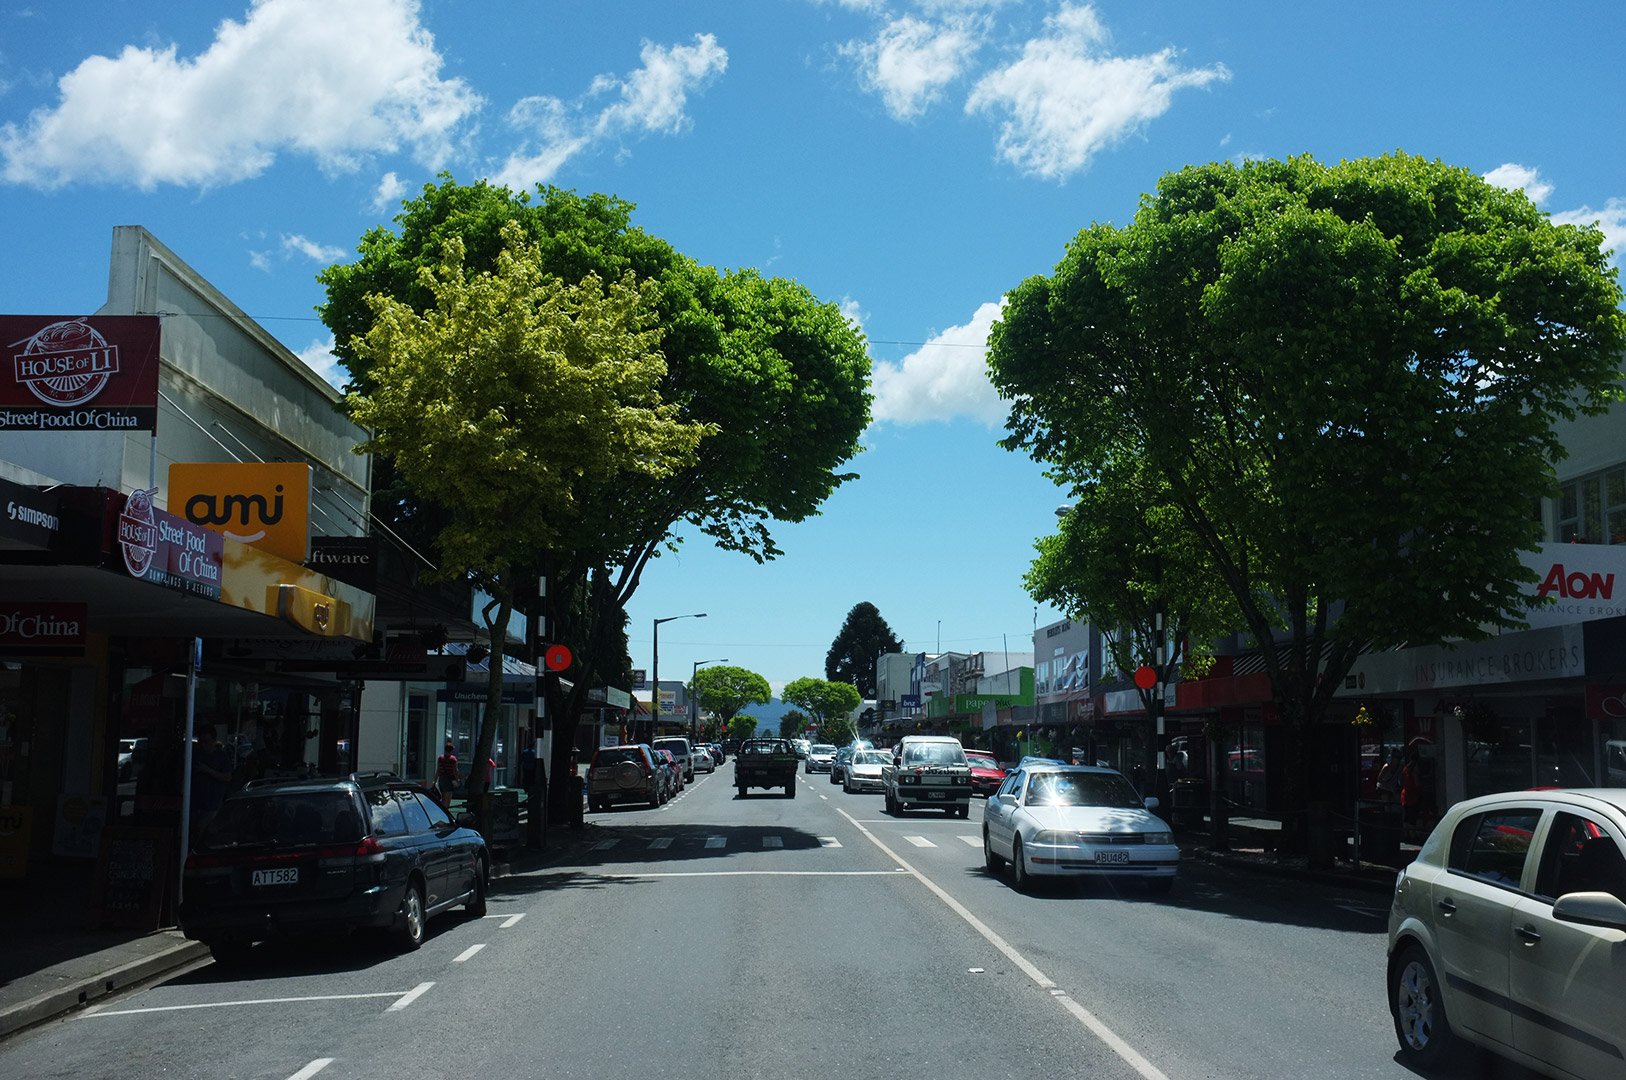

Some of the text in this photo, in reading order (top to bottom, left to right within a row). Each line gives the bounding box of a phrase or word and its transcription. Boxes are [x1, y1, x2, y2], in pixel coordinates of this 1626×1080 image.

[20, 355, 75, 376] HOUSE
[90, 349, 111, 371] LI
[0, 410, 39, 427] Street
[39, 410, 74, 429] Food
[95, 411, 138, 429] China
[184, 484, 284, 526] ami
[121, 520, 142, 542] HOUSE
[146, 528, 155, 548] LI
[159, 520, 206, 554] Street Food
[179, 552, 218, 581] Of China
[312, 550, 370, 564] ftware
[149, 569, 182, 589] DUMPLINGS
[192, 583, 213, 597] KEBABS
[1536, 563, 1615, 600] AON
[1514, 604, 1582, 615] SURANCE
[18, 614, 80, 638] China
[1415, 645, 1579, 682] INSURANCE BROKERS
[454, 692, 488, 700] Unichem
[966, 699, 989, 709] pape
[1096, 853, 1128, 863] ABU482
[253, 869, 297, 885] ATT582
